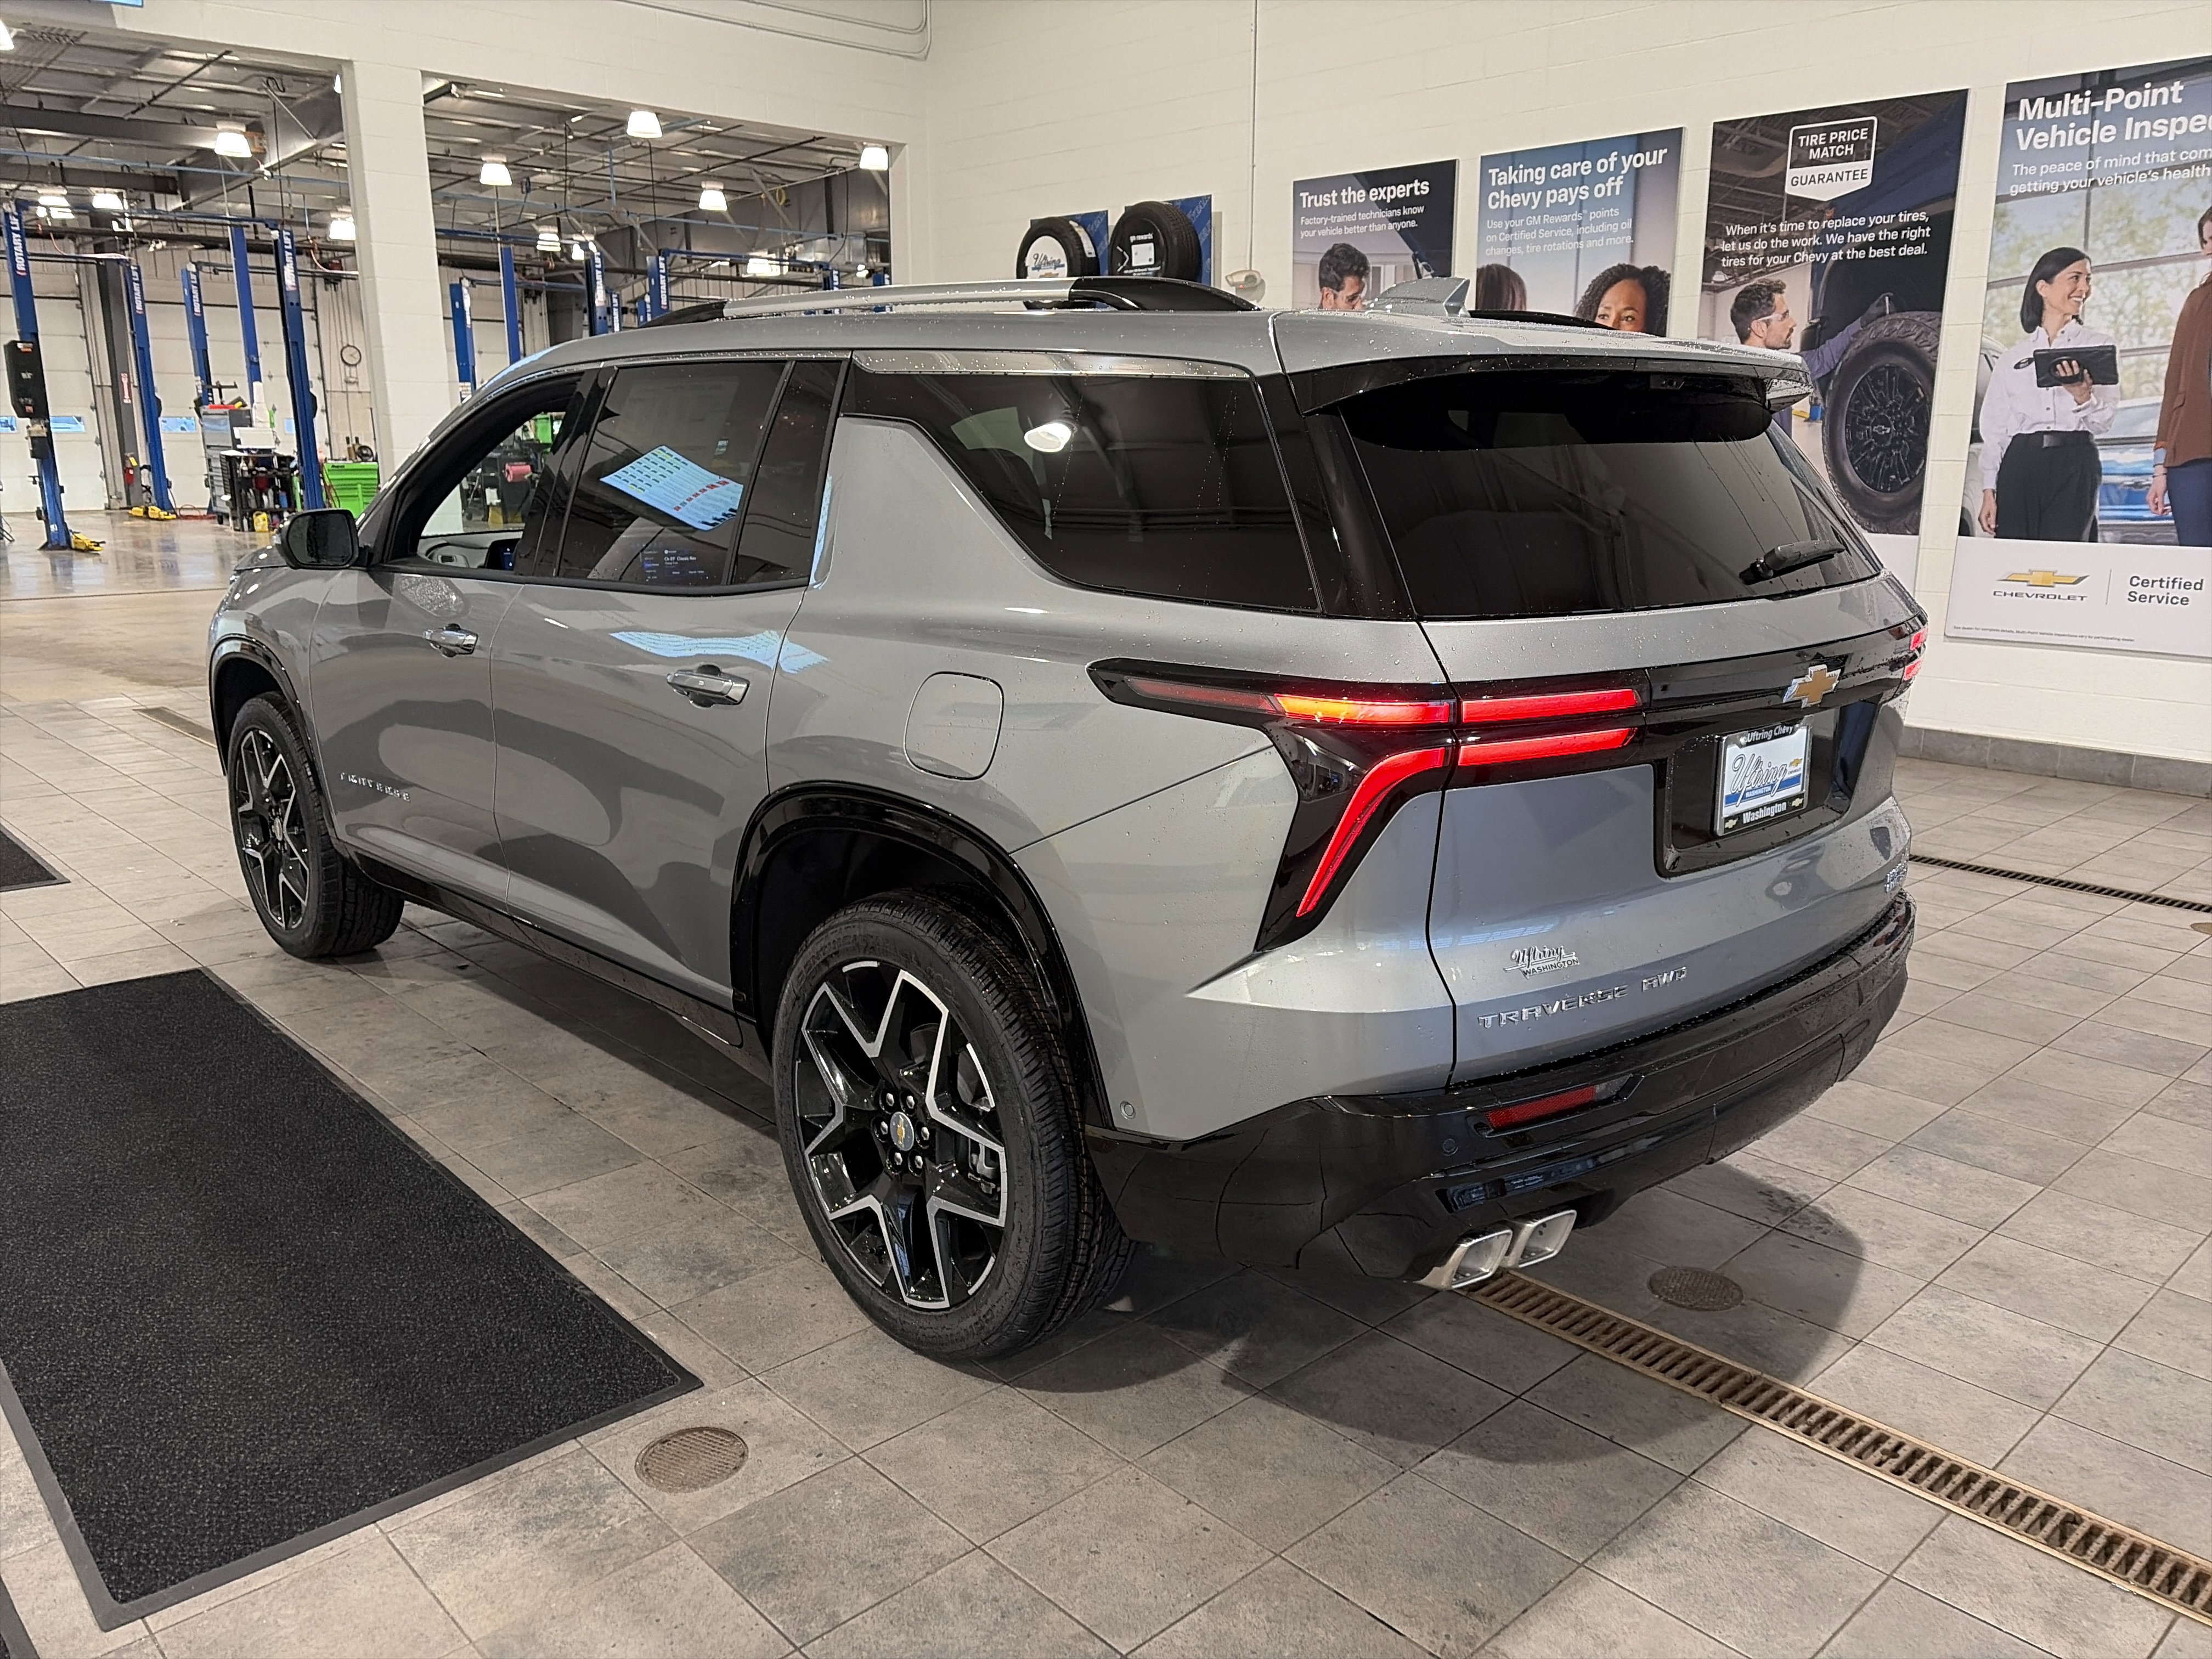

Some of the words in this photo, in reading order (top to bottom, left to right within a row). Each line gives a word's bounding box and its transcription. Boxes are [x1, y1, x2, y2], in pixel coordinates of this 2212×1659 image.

[2018, 81, 2184, 120] Multi-Point
[1799, 133, 1826, 147] TIRE
[1830, 128, 1869, 143] PRICE
[2016, 120, 2117, 150] Vehicle
[1809, 144, 1854, 160] MATCH
[2013, 164, 2036, 176] The
[2041, 161, 2083, 174] peace
[2087, 157, 2102, 170] of
[2104, 153, 2140, 168] mind
[2145, 149, 2176, 164] that
[1488, 165, 1546, 186] Taking
[1551, 160, 1592, 179] care
[1597, 151, 1617, 173] of
[1621, 149, 1668, 174] your
[1791, 168, 1868, 187] GUARANTEE
[1300, 190, 1338, 208] Trust
[1341, 187, 1365, 204] the
[1370, 179, 1429, 202] experts
[1488, 190, 1542, 209] Chevy
[1546, 185, 1589, 207] pays
[1594, 176, 1623, 198] off
[2010, 178, 2059, 195] getting
[2062, 178, 2094, 191] your
[2097, 171, 2159, 187] vehicle's
[1301, 212, 1356, 225] Factory-trained
[1358, 208, 1401, 219] technicians
[1403, 205, 1424, 216] know
[1487, 220, 1503, 229] Use
[1505, 218, 1525, 230] your
[1527, 215, 1541, 225] GM
[1589, 207, 1619, 221] points
[1725, 224, 1757, 236] When
[1759, 222, 1776, 234] it's
[1779, 221, 1805, 233] time
[1808, 219, 1820, 230] to
[1822, 215, 1866, 232] replace
[1869, 215, 1896, 227] your
[1899, 211, 1929, 224] tires,
[1301, 230, 1316, 239] your
[1318, 226, 1342, 236] vehicle
[1344, 225, 1367, 234] better
[1369, 223, 1386, 232] than
[1388, 219, 1418, 231] anyone.
[1499, 229, 1537, 241] Certified
[1539, 227, 1573, 238] Service,
[1577, 221, 1618, 235] including
[1621, 219, 1632, 230] oil
[1722, 241, 1736, 251] let
[1739, 241, 1751, 250] us
[1754, 238, 1768, 250] do
[1771, 236, 1789, 249] the
[1792, 235, 1822, 247] work.
[1826, 234, 1844, 245] We
[1847, 230, 1875, 243] have
[1878, 228, 1898, 240] the
[1901, 226, 1931, 241] right
[12, 232, 26, 271] ROTARY
[1486, 246, 1523, 256] changes,
[1526, 244, 1541, 253] tire
[1543, 240, 1584, 252] rotations
[1587, 239, 1604, 249] and
[1606, 236, 1634, 246] more.
[1722, 256, 1745, 267] tires
[1748, 255, 1763, 266] for
[1766, 255, 1791, 267] your
[1794, 250, 1829, 264] Chevy
[1831, 250, 1843, 261] at
[1847, 248, 1865, 259] the
[1869, 245, 1895, 258] best
[1899, 243, 1927, 256] deal.
[2130, 575, 2204, 590] Certified
[1993, 590, 2087, 601] CHEVROLET
[2128, 590, 2190, 606] Service
[1747, 729, 1773, 743] Uftring
[1774, 725, 1793, 736] Chevy
[1743, 802, 1786, 823] Washington
[1522, 958, 1579, 977] WASHINGTON
[1478, 984, 1628, 1029] TRAVERSE
[1641, 967, 1688, 992] AWD
